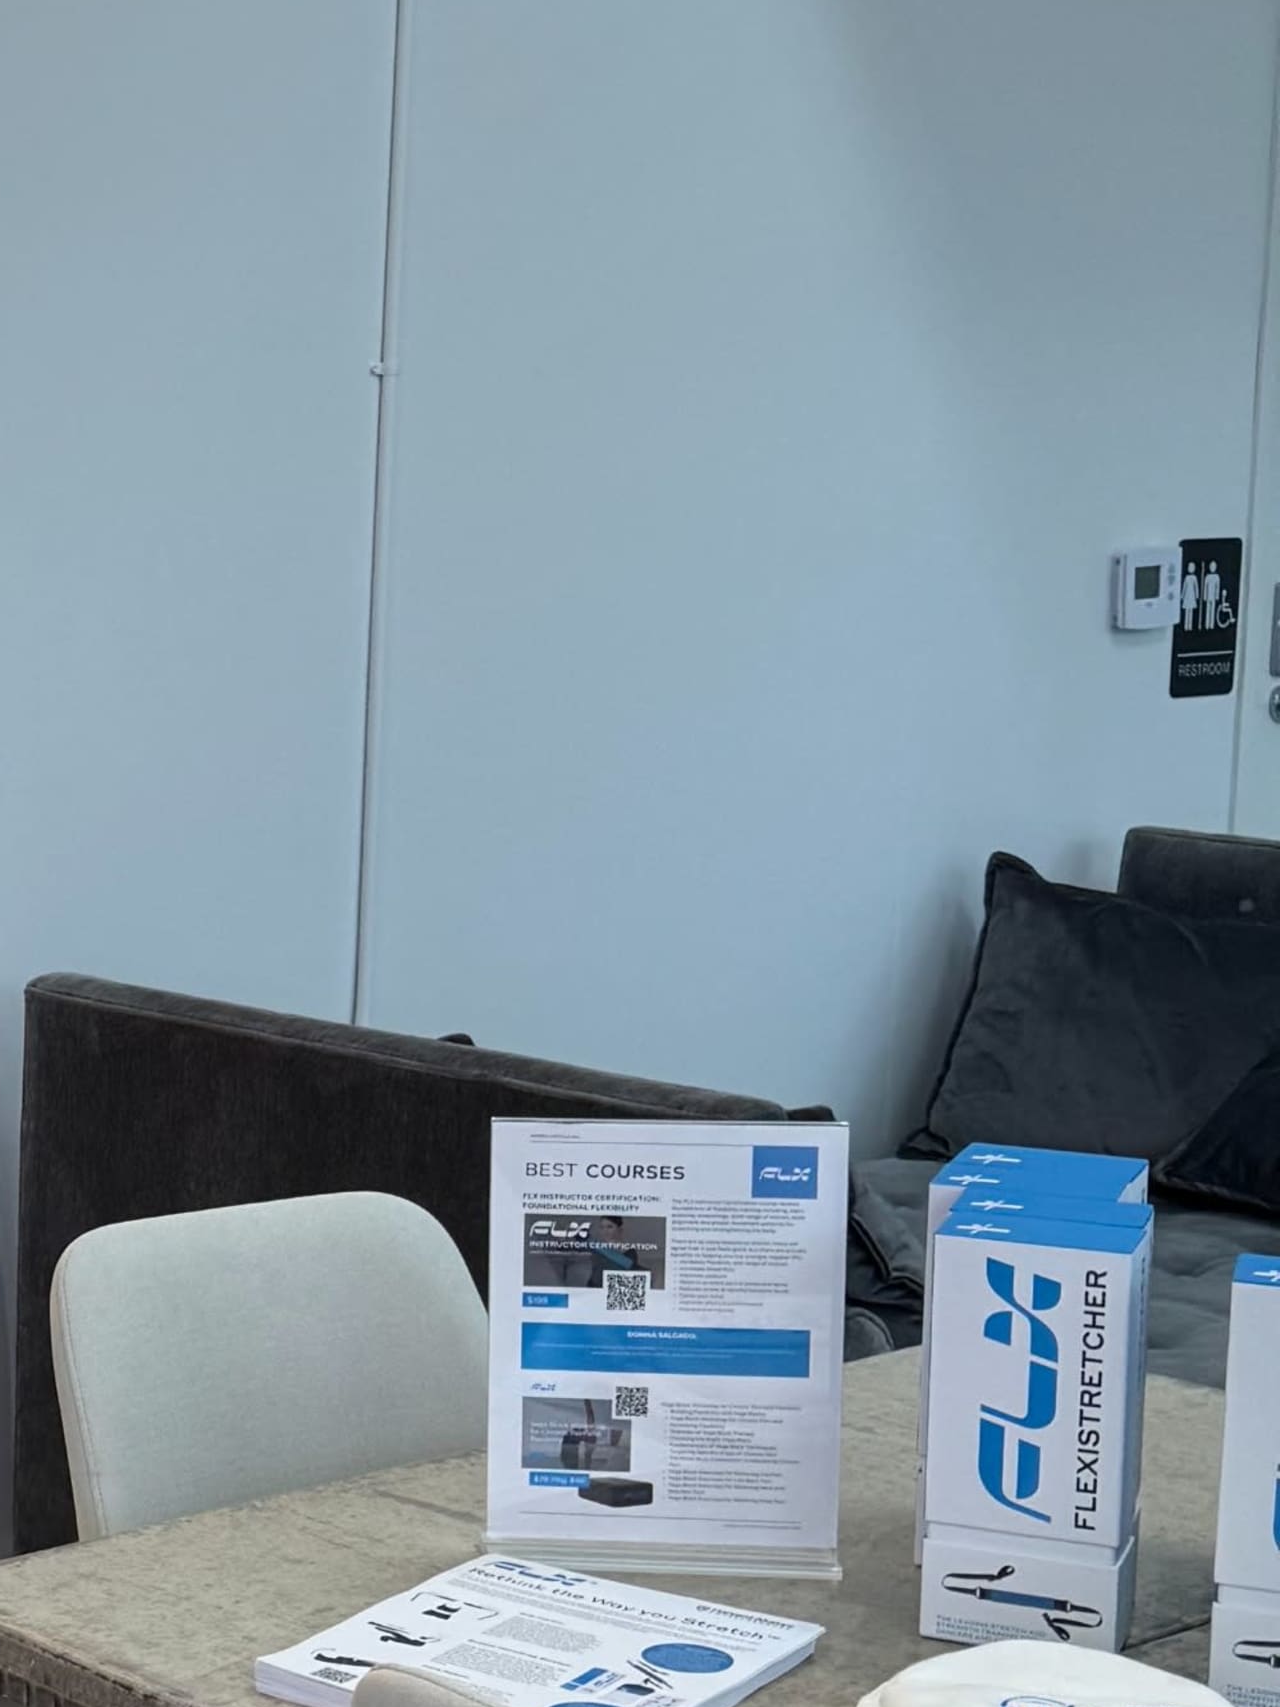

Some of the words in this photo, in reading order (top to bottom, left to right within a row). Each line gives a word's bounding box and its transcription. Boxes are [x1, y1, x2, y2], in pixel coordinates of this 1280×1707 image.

[1177, 662, 1231, 677] RESTROOM
[525, 1162, 578, 1178] BEST
[586, 1164, 686, 1181] COURSES
[759, 1166, 812, 1182] FLX
[540, 1193, 592, 1202] INSTRUCTOR
[522, 1202, 588, 1211] FOUNDATIONAL
[591, 1203, 640, 1212] FLEXIBILITY
[529, 1220, 592, 1238] FLX
[529, 1240, 588, 1250] INSTRUCTOR
[589, 1241, 658, 1251] CERTIFICATION
[977, 1256, 1063, 1525] FLX
[1074, 1269, 1108, 1532] FLEXISTRETCHER
[468, 1567, 545, 1592] Rethink
[551, 1588, 585, 1600] the
[591, 1596, 636, 1612] Way
[639, 1609, 677, 1622] you
